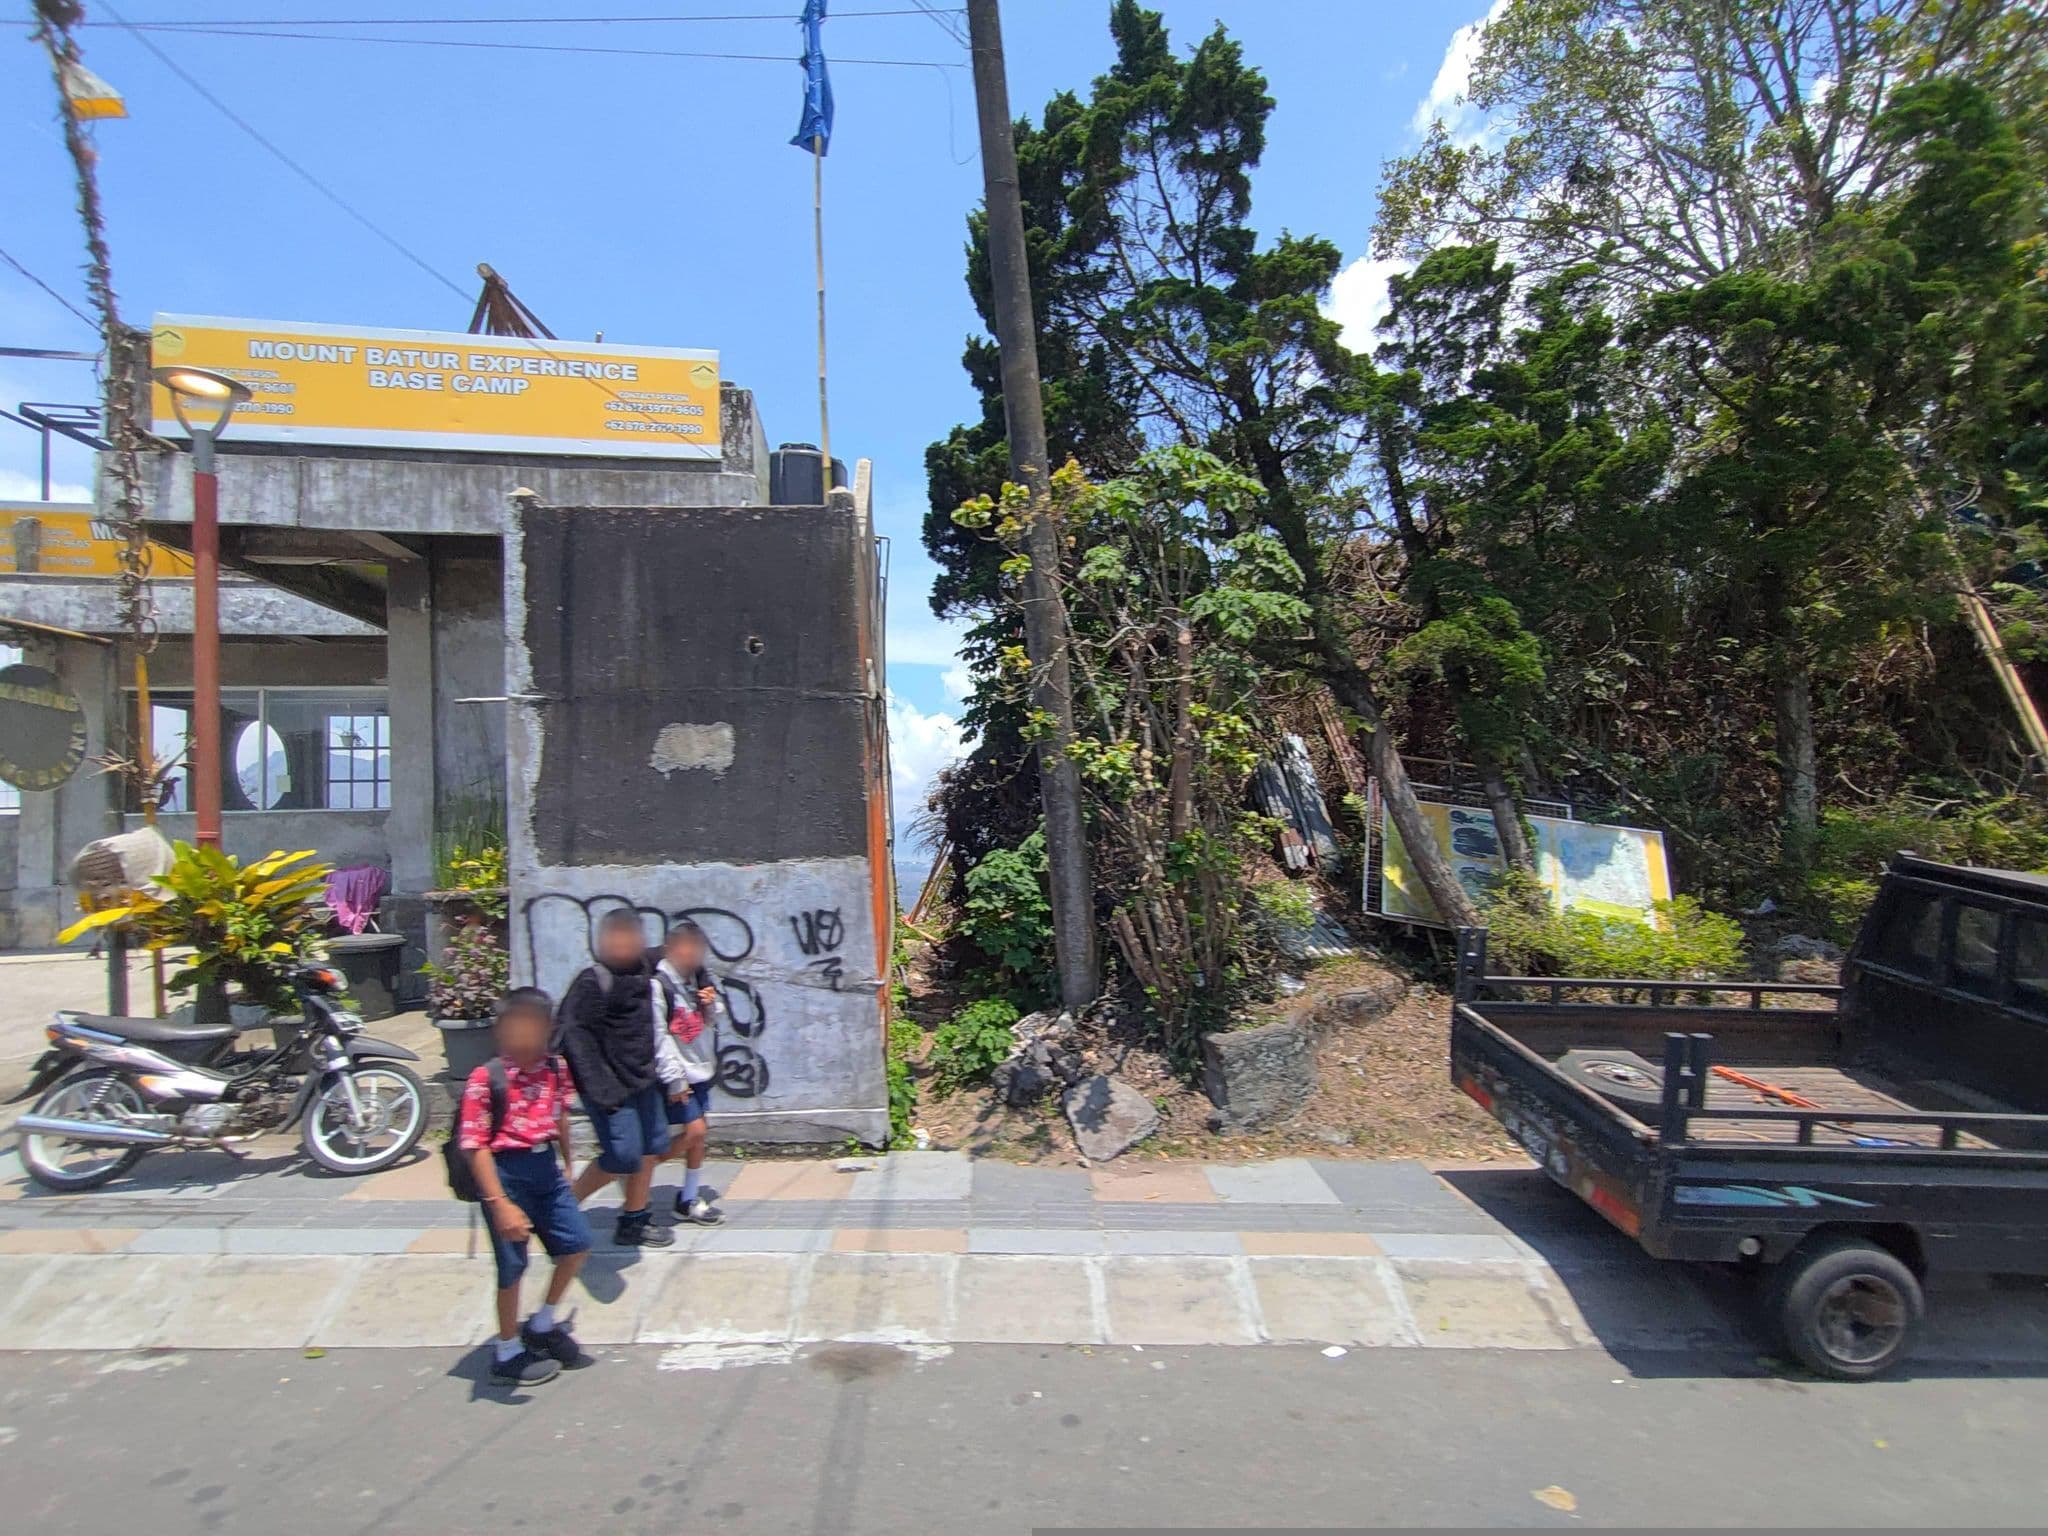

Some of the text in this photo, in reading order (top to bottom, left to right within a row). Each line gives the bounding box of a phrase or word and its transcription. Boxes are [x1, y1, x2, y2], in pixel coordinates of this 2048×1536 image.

[250, 341, 638, 381] MOUNT BATUR EXPERIENCE
[370, 370, 530, 395] BASE CAMP
